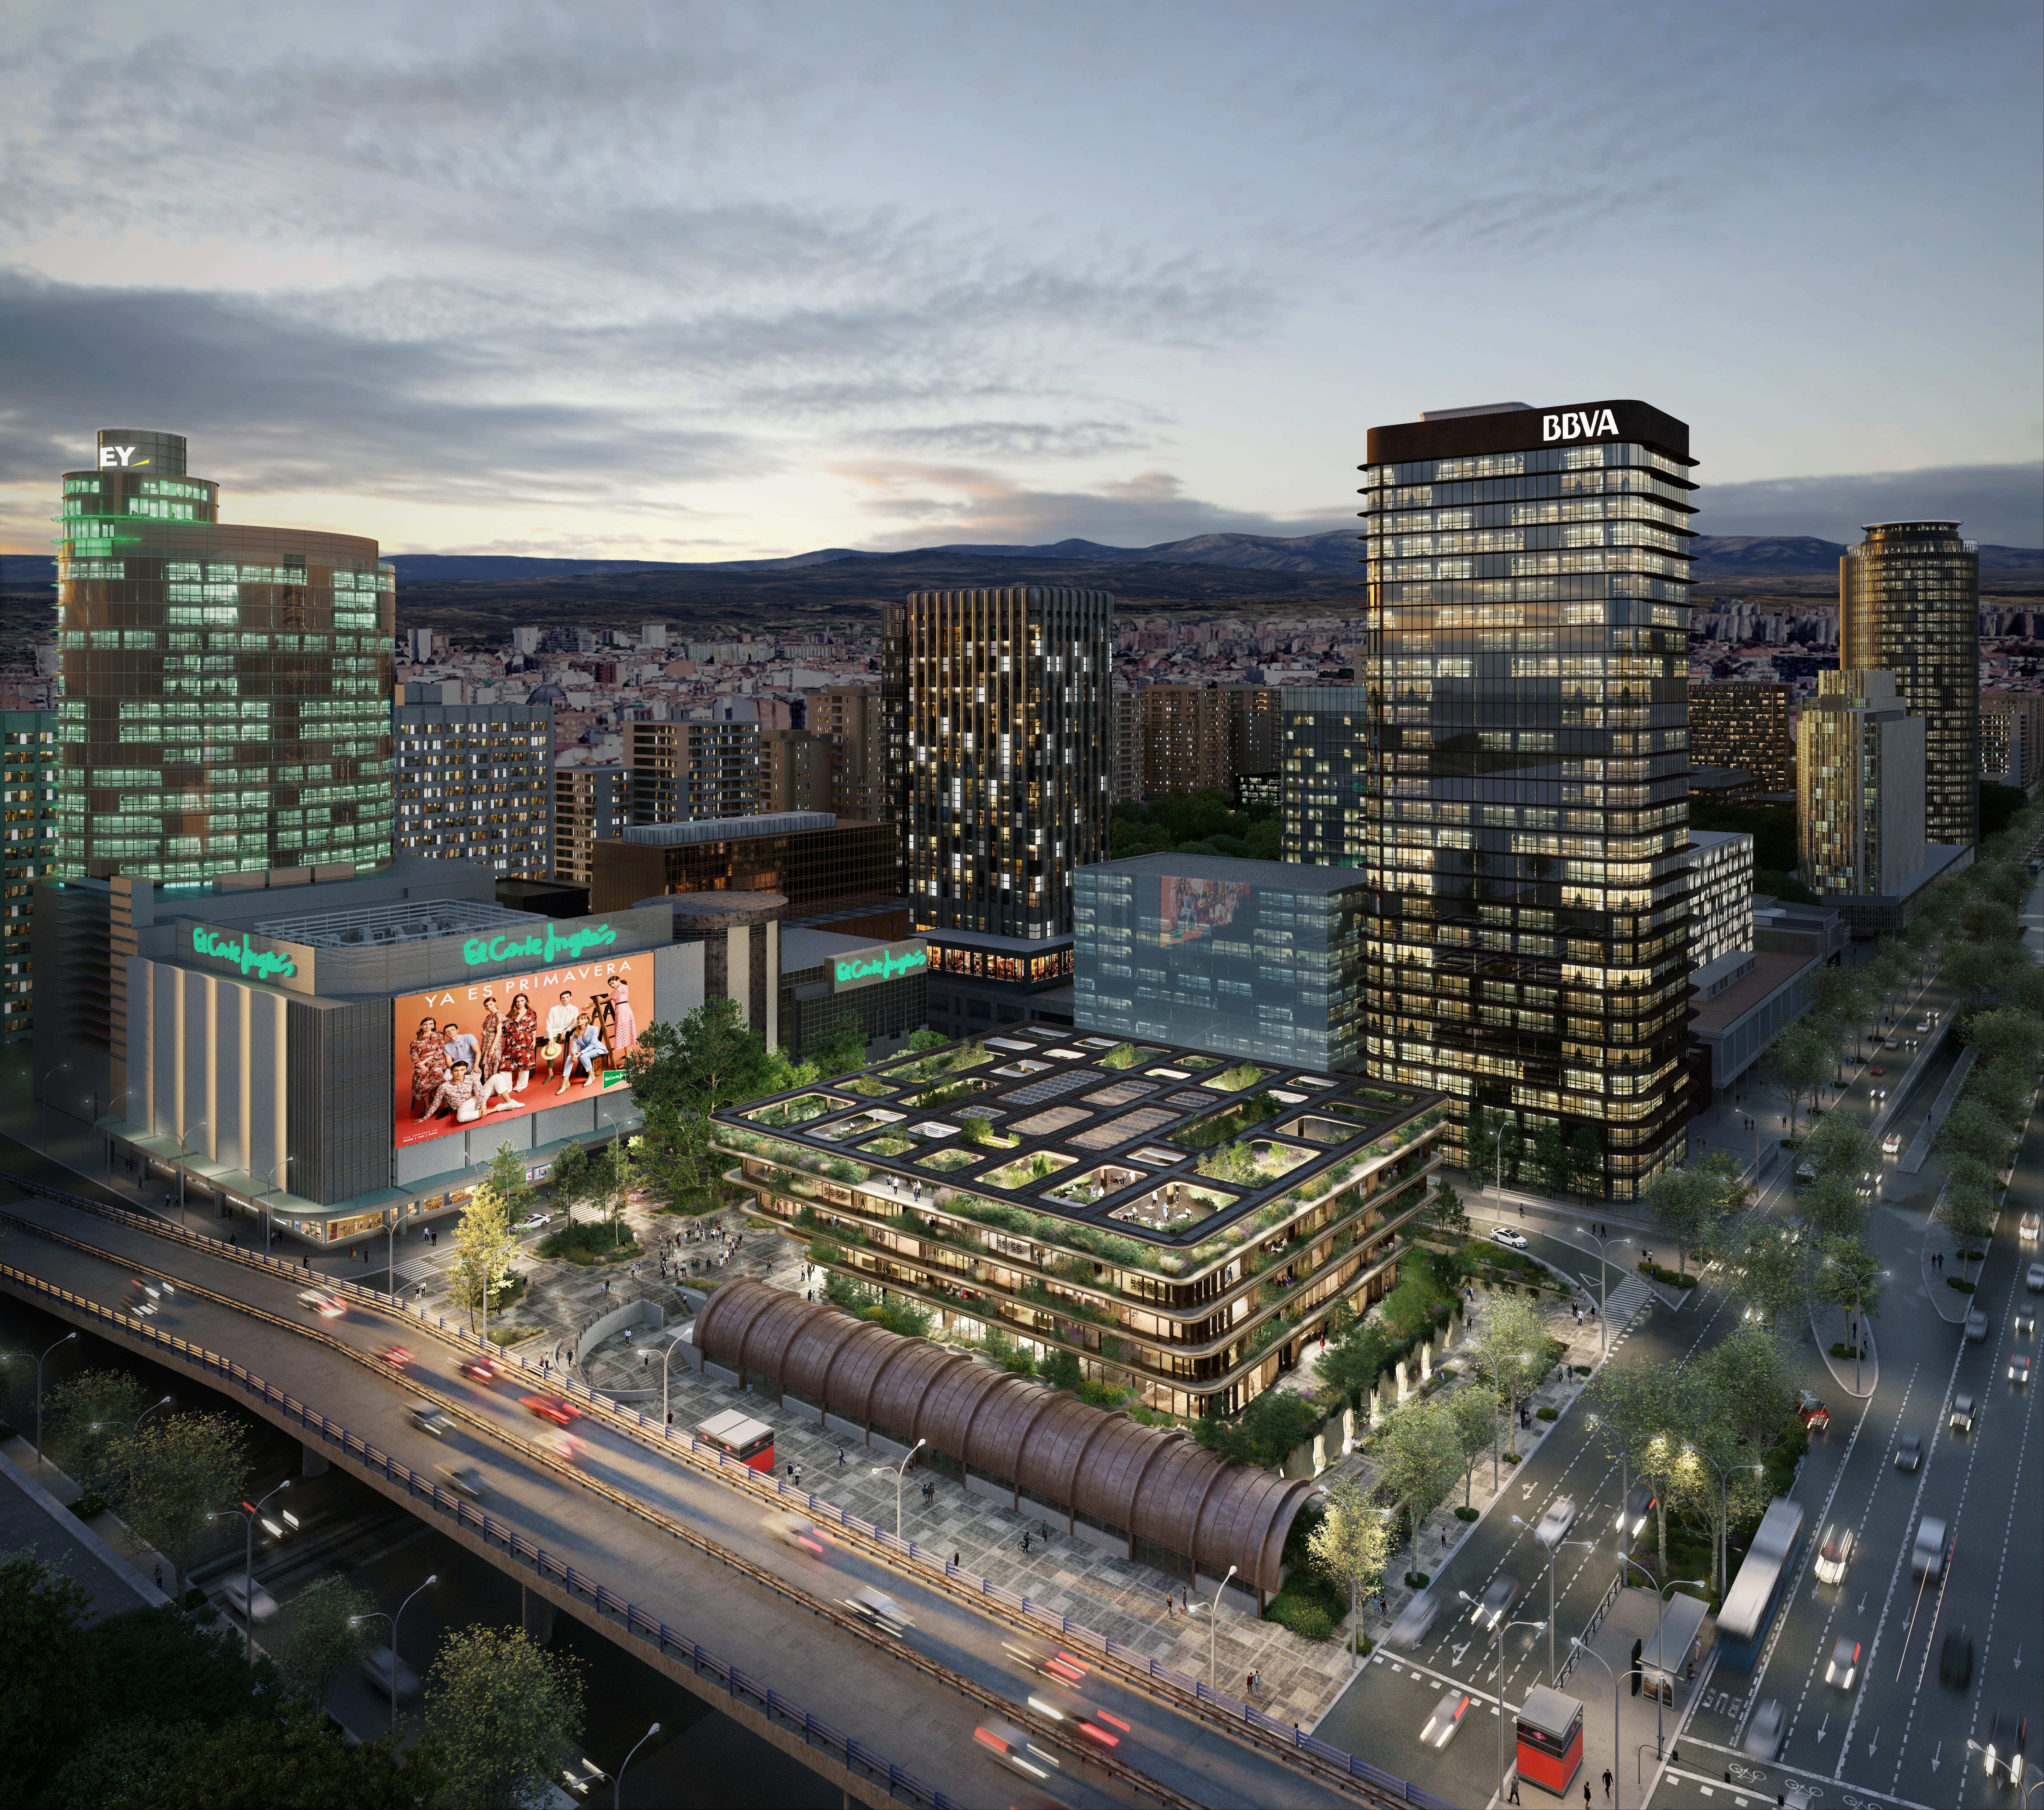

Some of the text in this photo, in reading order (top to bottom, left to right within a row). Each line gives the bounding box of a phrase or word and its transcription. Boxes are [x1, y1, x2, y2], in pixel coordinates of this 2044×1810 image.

[1543, 409, 1619, 441] BBVA
[100, 446, 136, 467] EY
[463, 938, 489, 965] El
[489, 935, 542, 961] Corte
[425, 960, 632, 1008] YA ES PRIMAVERA
[1702, 1687, 1743, 1718] BUS
